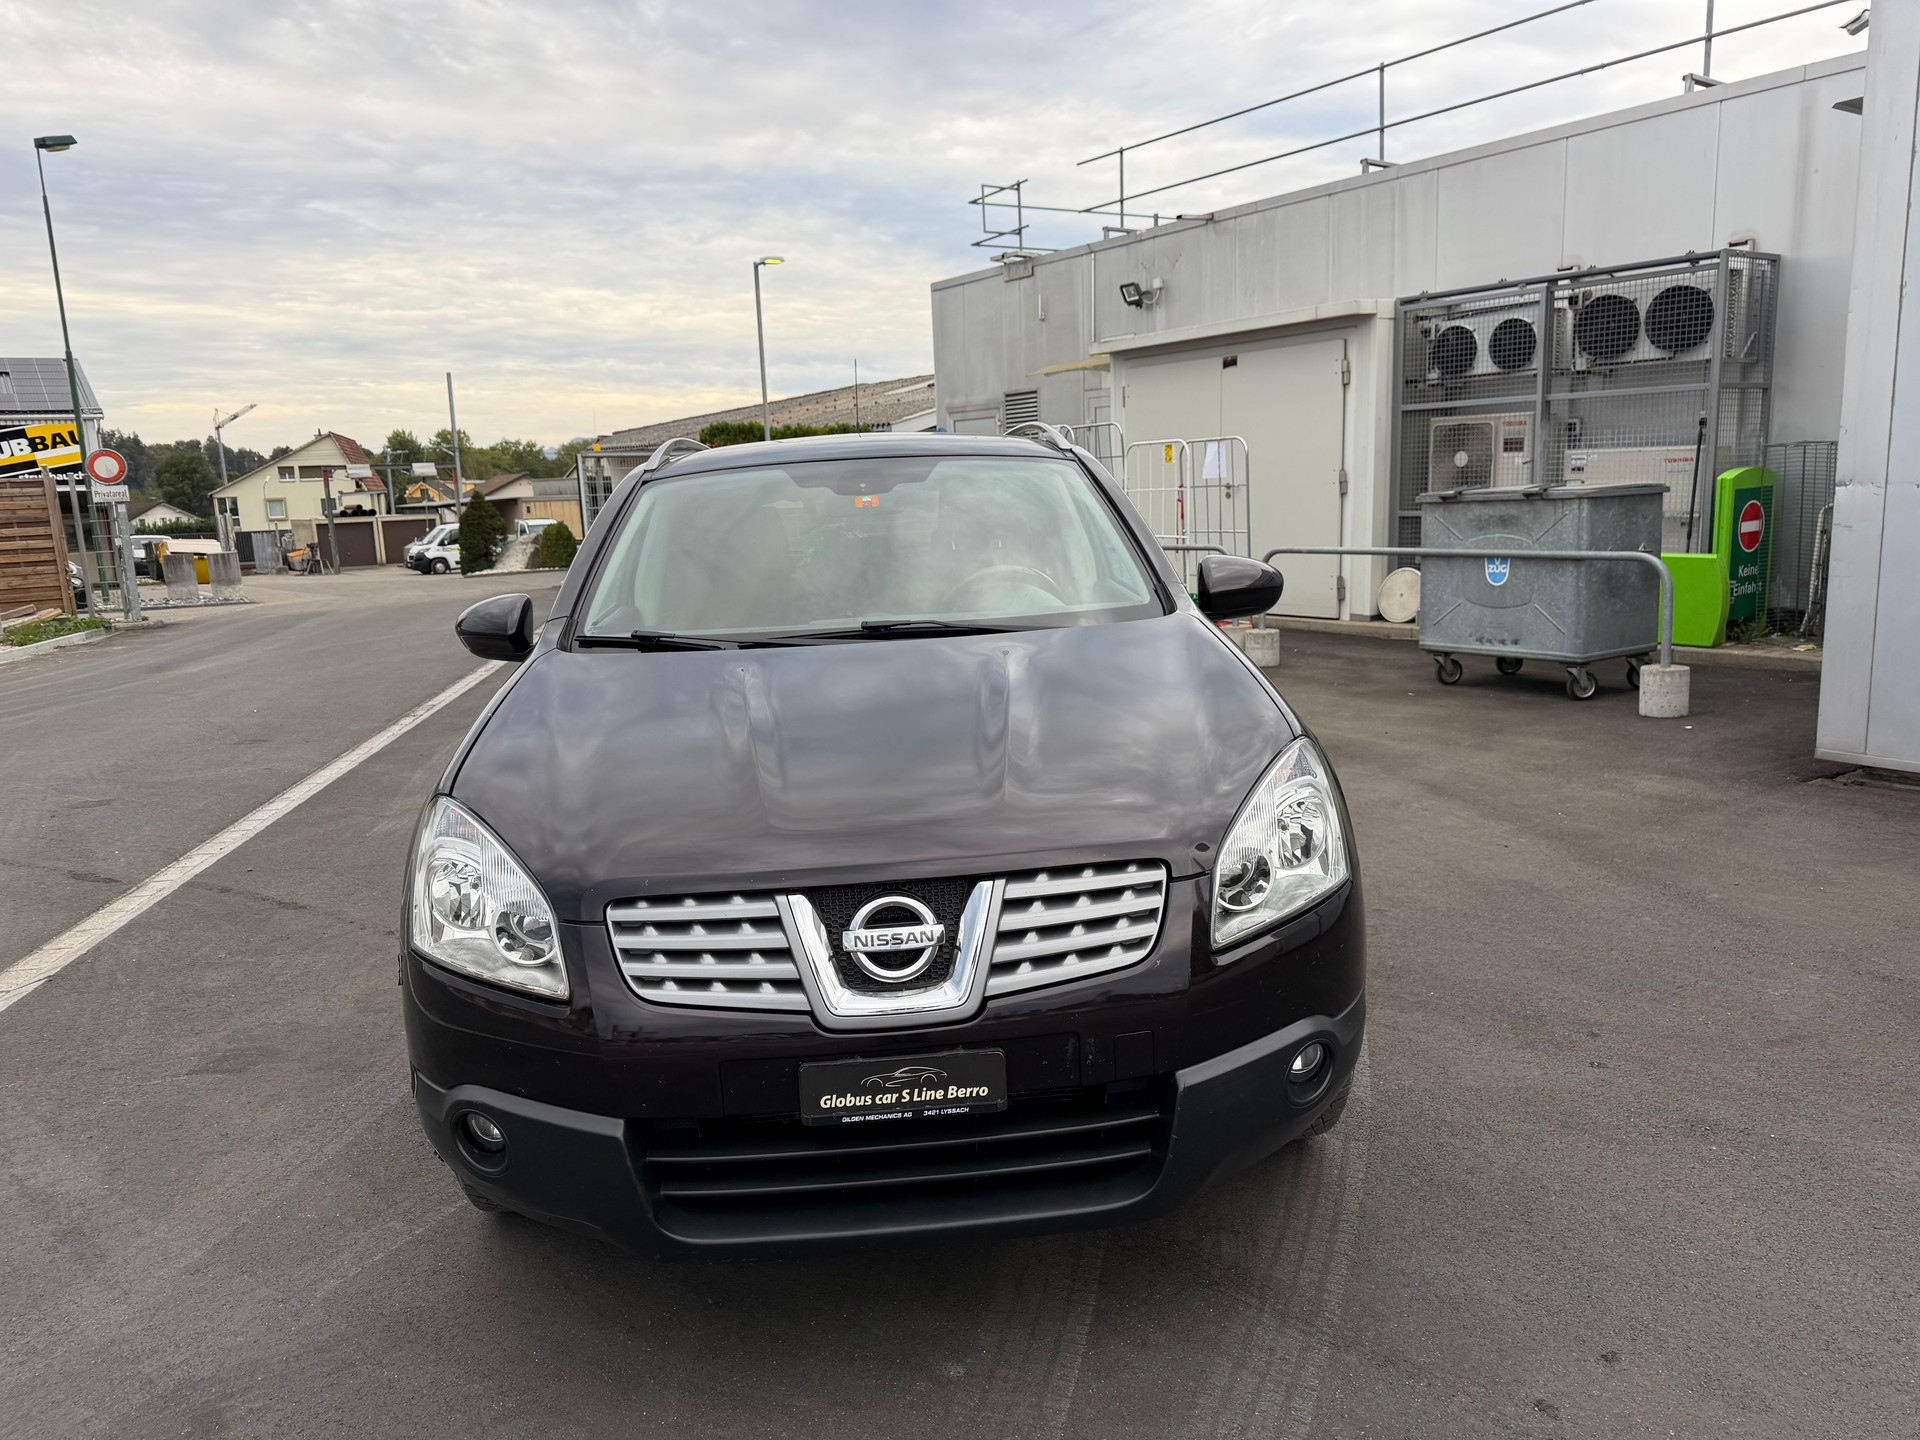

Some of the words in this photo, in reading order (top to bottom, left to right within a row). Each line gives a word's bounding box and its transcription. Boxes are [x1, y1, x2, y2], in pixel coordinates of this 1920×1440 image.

[94, 489, 128, 499] Privatareal
[1738, 563, 1759, 578] Keine
[854, 930, 935, 948] NISSAN
[819, 1093, 872, 1109] Globus
[875, 1092, 899, 1105] car
[901, 1089, 910, 1103] S
[913, 1087, 944, 1102] Line
[947, 1085, 989, 1099] Berro
[865, 1112, 902, 1121] MECHANICS
[940, 1107, 970, 1115] LYSSACH
